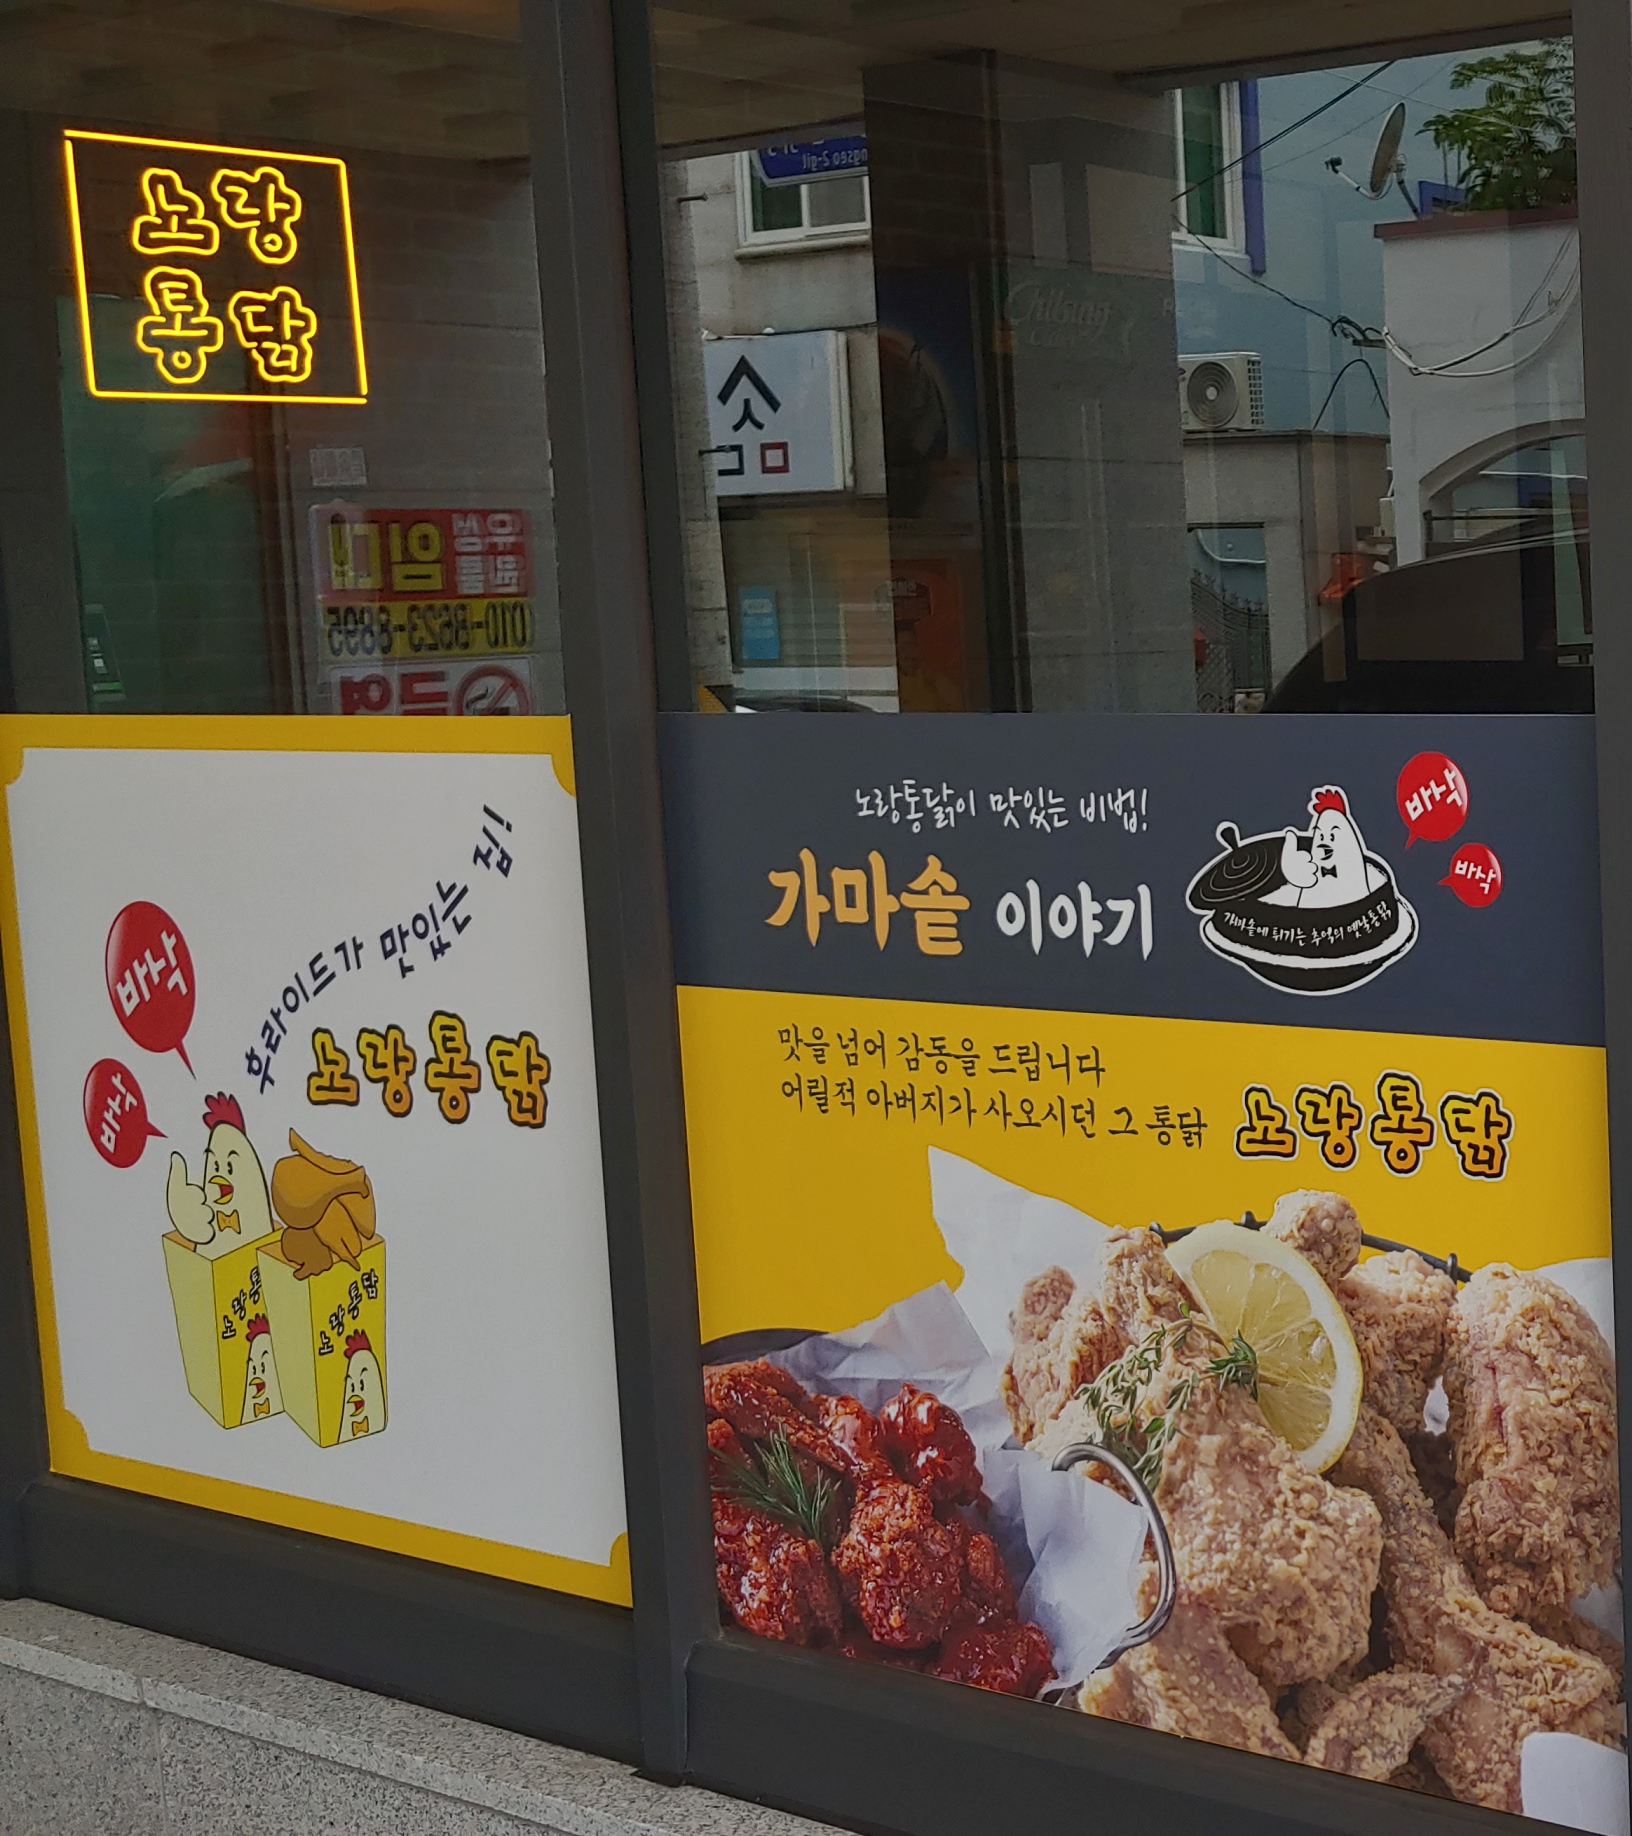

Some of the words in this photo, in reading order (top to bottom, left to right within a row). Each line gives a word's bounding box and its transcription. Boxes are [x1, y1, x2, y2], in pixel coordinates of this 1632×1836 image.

[132, 166, 303, 265] 노랑
[855, 779, 976, 833] 노랑통닭이
[989, 786, 1069, 833] 맛있는
[1079, 788, 1149, 833] 비법!
[1405, 768, 1463, 822] 바삭
[765, 848, 971, 957] 가마솥
[996, 878, 1154, 961] 이야기
[1454, 859, 1497, 895] 바삭
[116, 930, 188, 1017] 바삭
[245, 936, 364, 1094] 후라이드가
[379, 880, 472, 979] 맛있는
[473, 804, 512, 878] 집!
[1272, 927, 1307, 947] 튀기는
[1311, 927, 1344, 946] 추억의
[306, 1010, 550, 1129] 노랑통닭
[777, 1023, 831, 1064] 맛을
[836, 1028, 887, 1069] 넘어
[896, 1035, 981, 1077] 감동을
[987, 1041, 1106, 1089] 드립니다
[101, 1073, 138, 1153] 바삭
[781, 1072, 856, 1117] 어릴적
[866, 1081, 977, 1128] 아버지가
[983, 1090, 1096, 1139] 사오시던
[1107, 1106, 1139, 1136] 그
[1145, 1104, 1208, 1150] 통닭
[1235, 1069, 1513, 1180] 노랑통닭
